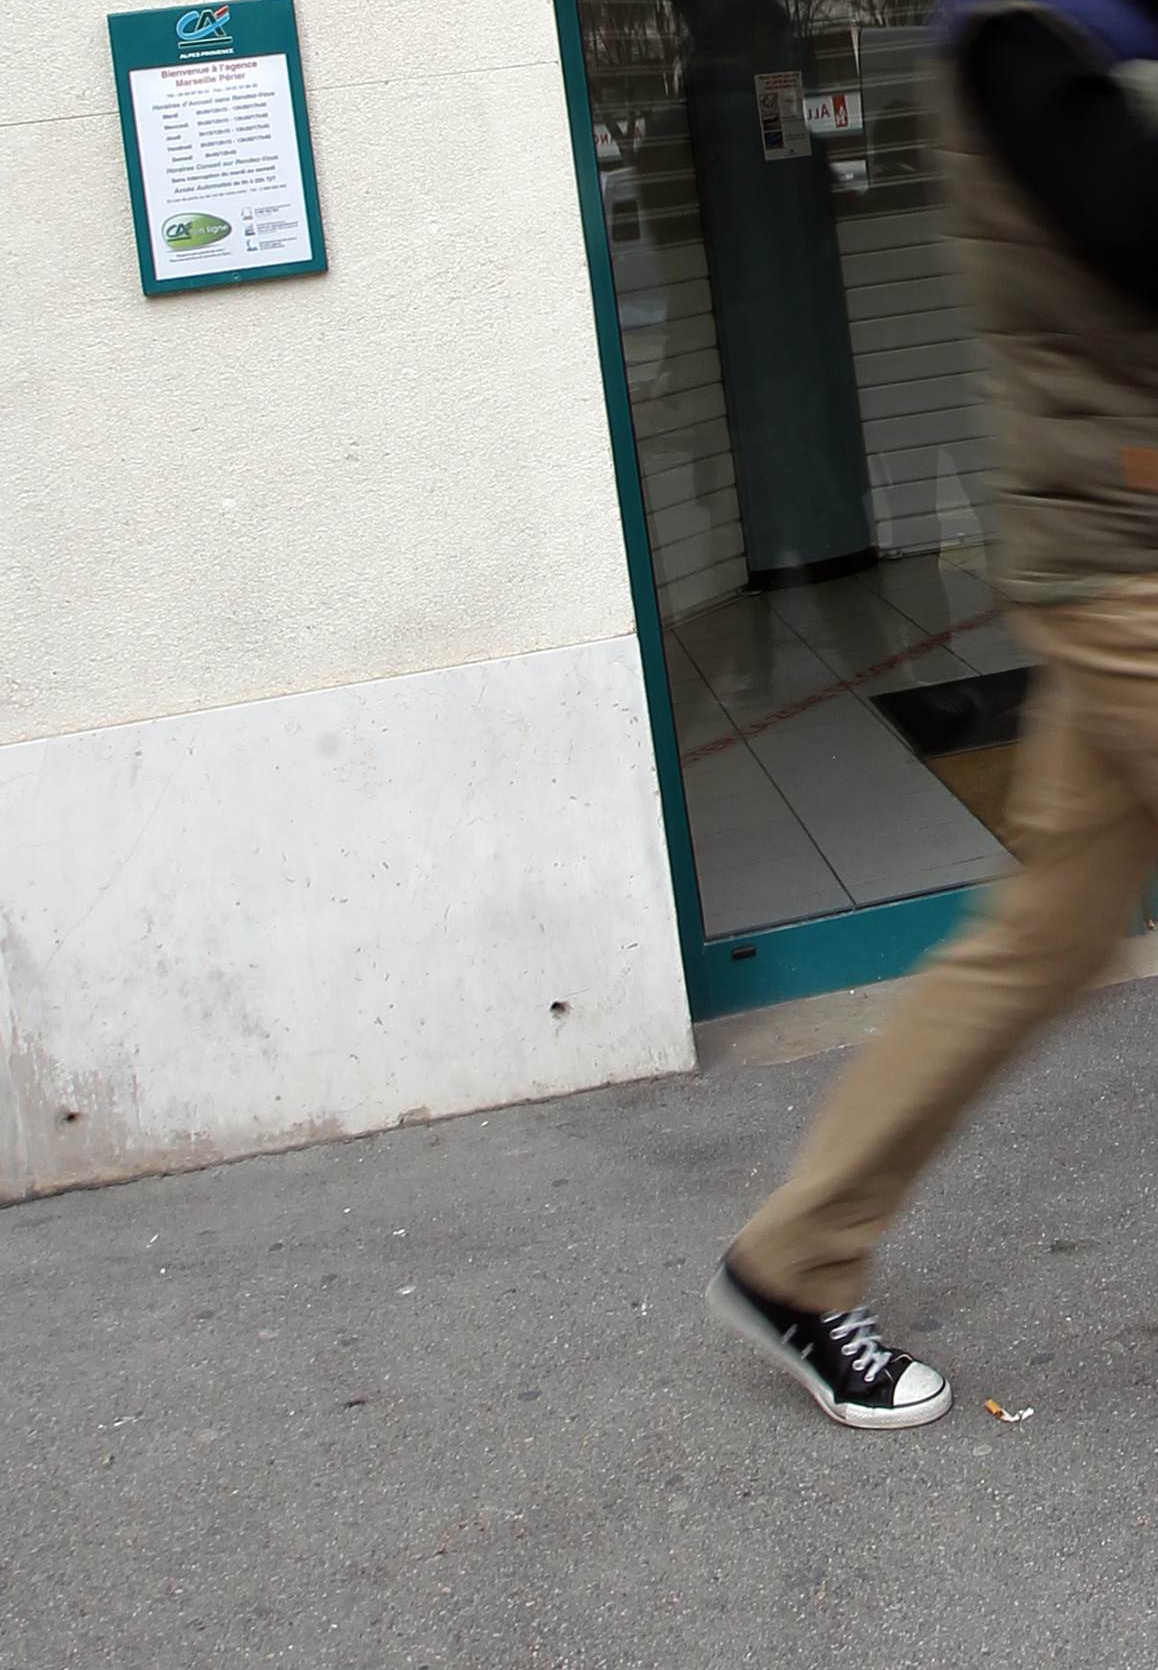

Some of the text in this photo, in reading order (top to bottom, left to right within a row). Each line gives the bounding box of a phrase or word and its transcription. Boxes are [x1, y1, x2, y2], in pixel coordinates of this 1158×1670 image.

[161, 66, 210, 79] Bienvenue
[219, 60, 258, 73] l'agence
[175, 75, 217, 87] Marseille
